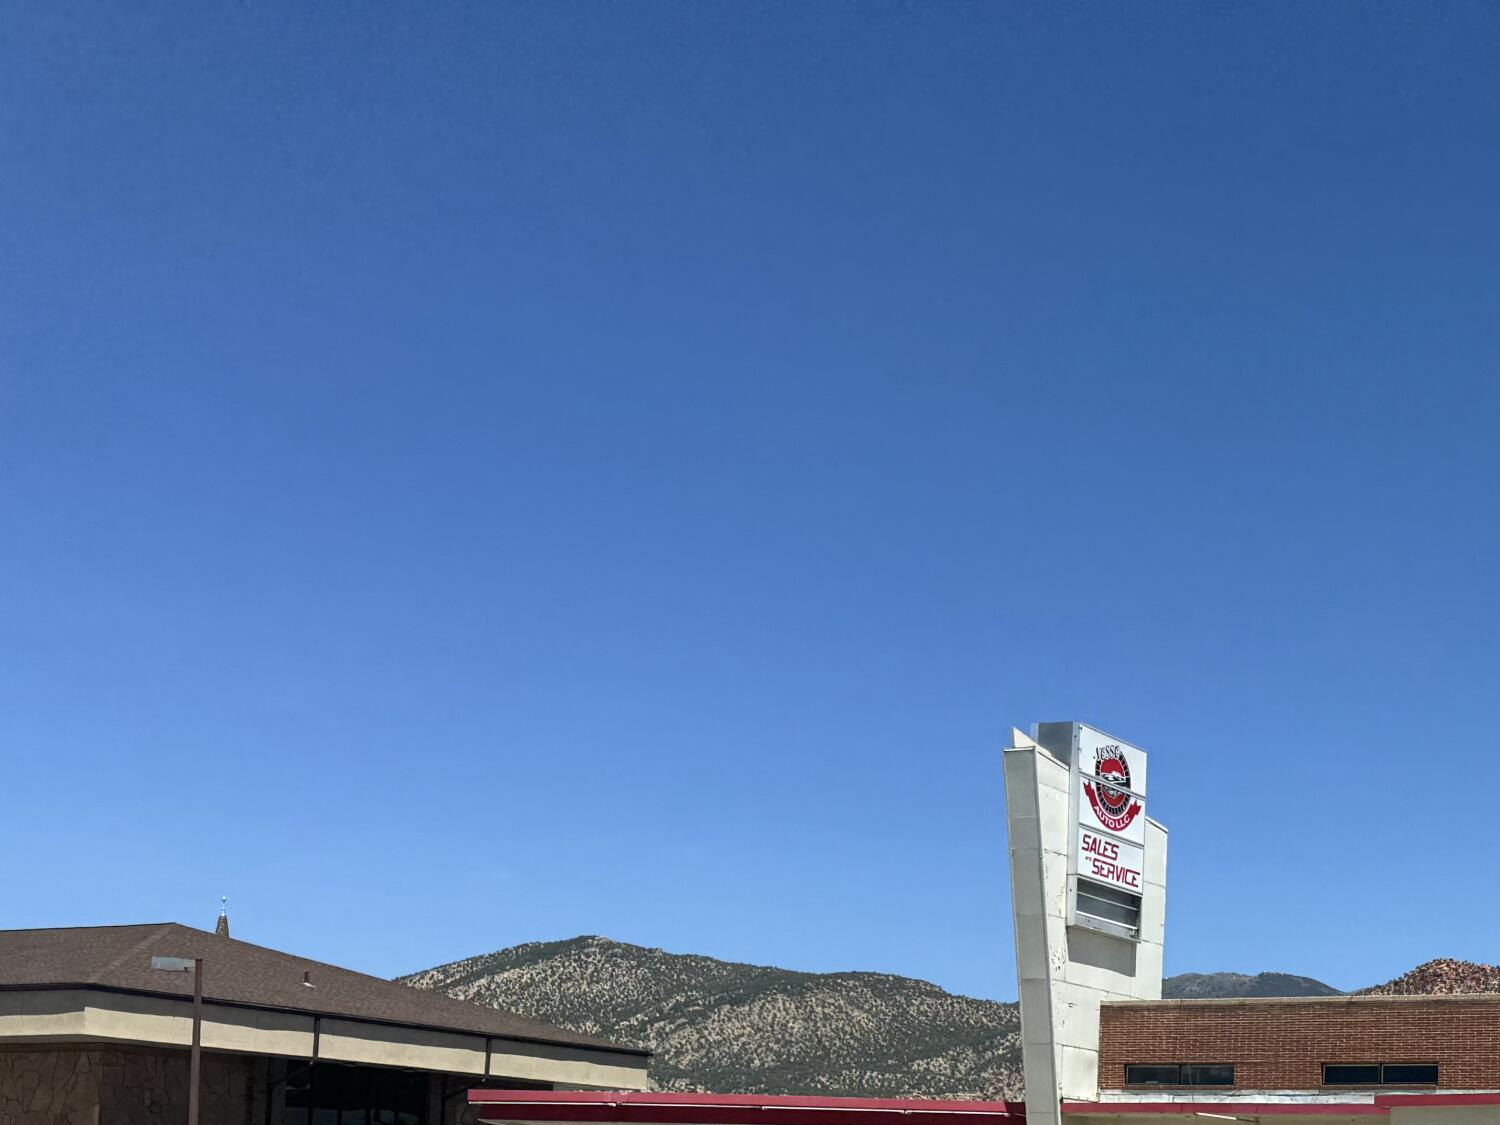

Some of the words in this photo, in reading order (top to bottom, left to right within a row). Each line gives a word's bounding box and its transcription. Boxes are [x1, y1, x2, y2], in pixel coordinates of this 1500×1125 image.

[1094, 806, 1114, 828] AUTO
[1115, 814, 1130, 829] LLC
[1082, 834, 1119, 861] SALES
[1092, 858, 1140, 888] SERVICE
